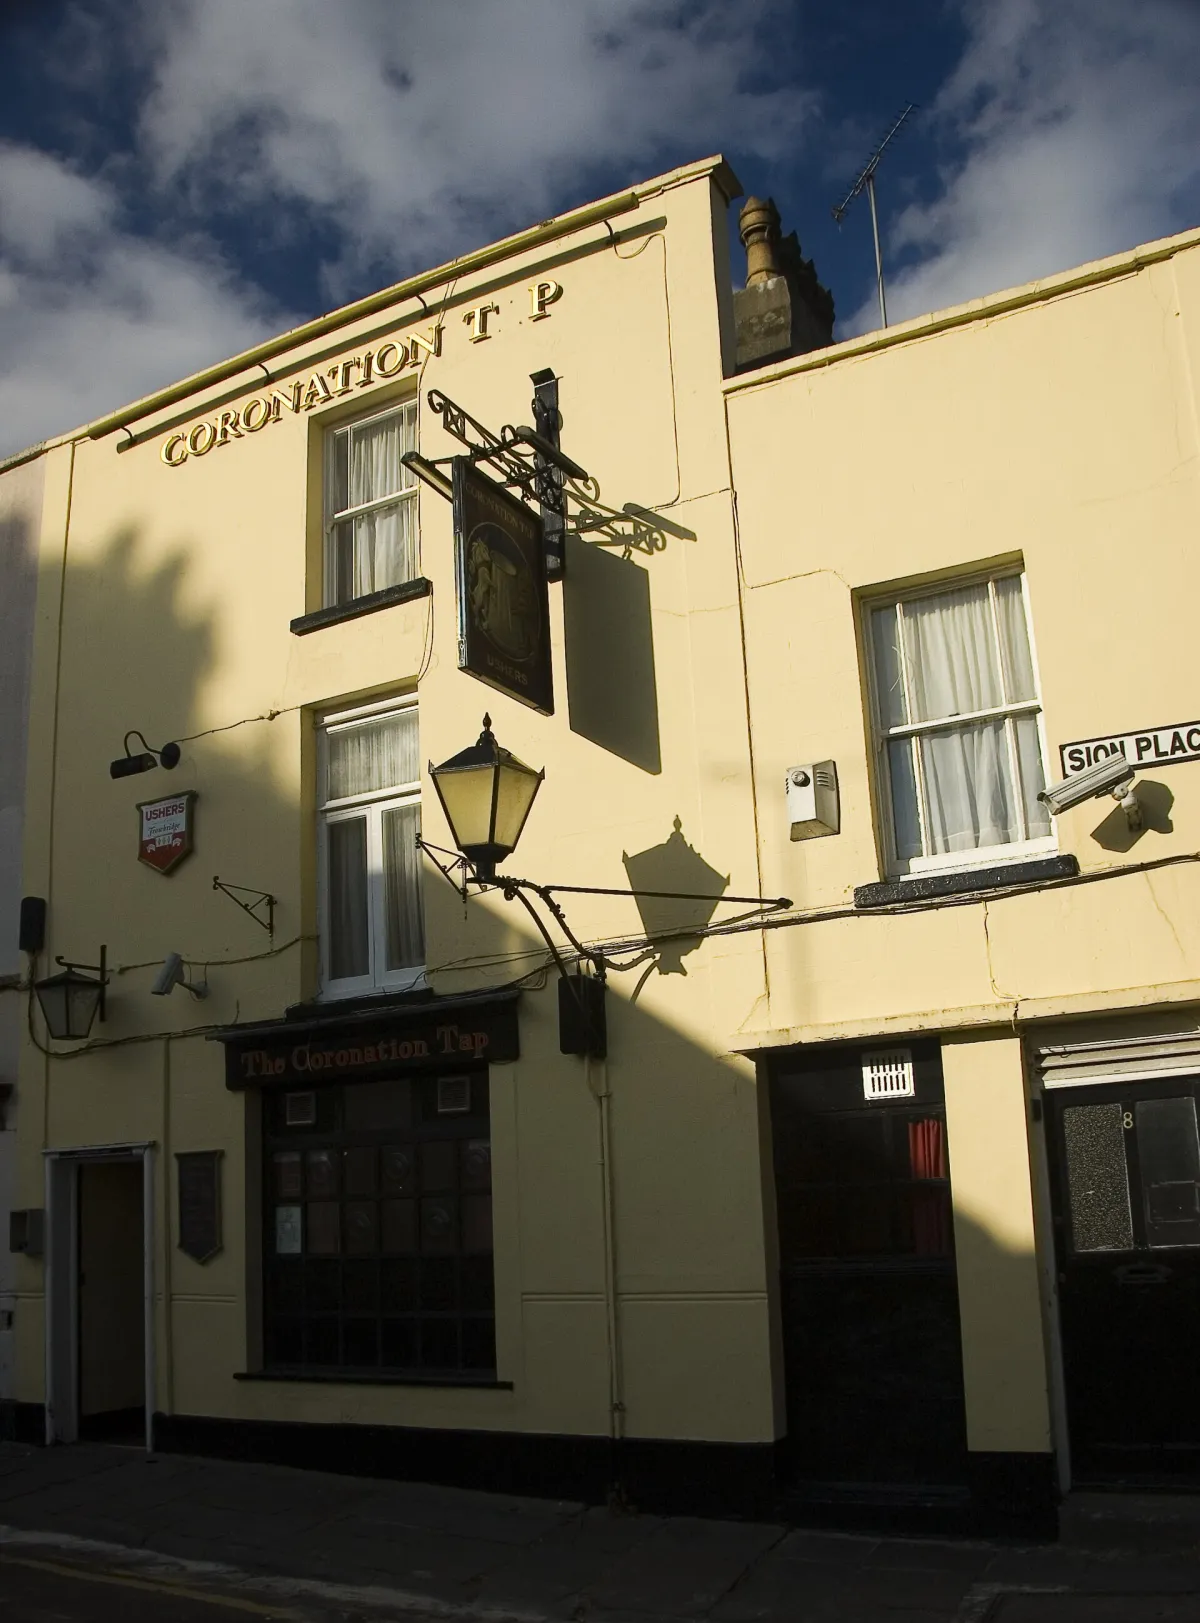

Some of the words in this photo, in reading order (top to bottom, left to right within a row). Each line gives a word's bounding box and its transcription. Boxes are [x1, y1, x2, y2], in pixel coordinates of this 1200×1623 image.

[160, 324, 444, 467] CORONATION
[486, 652, 528, 686] USHERS
[1068, 740, 1126, 771] SION
[1135, 728, 1200, 761] PLAC
[145, 802, 185, 821] USHERS
[241, 1048, 286, 1078] The
[291, 1038, 430, 1071] Coronation
[436, 1025, 489, 1059] Tap
[1123, 1112, 1133, 1128] 8
